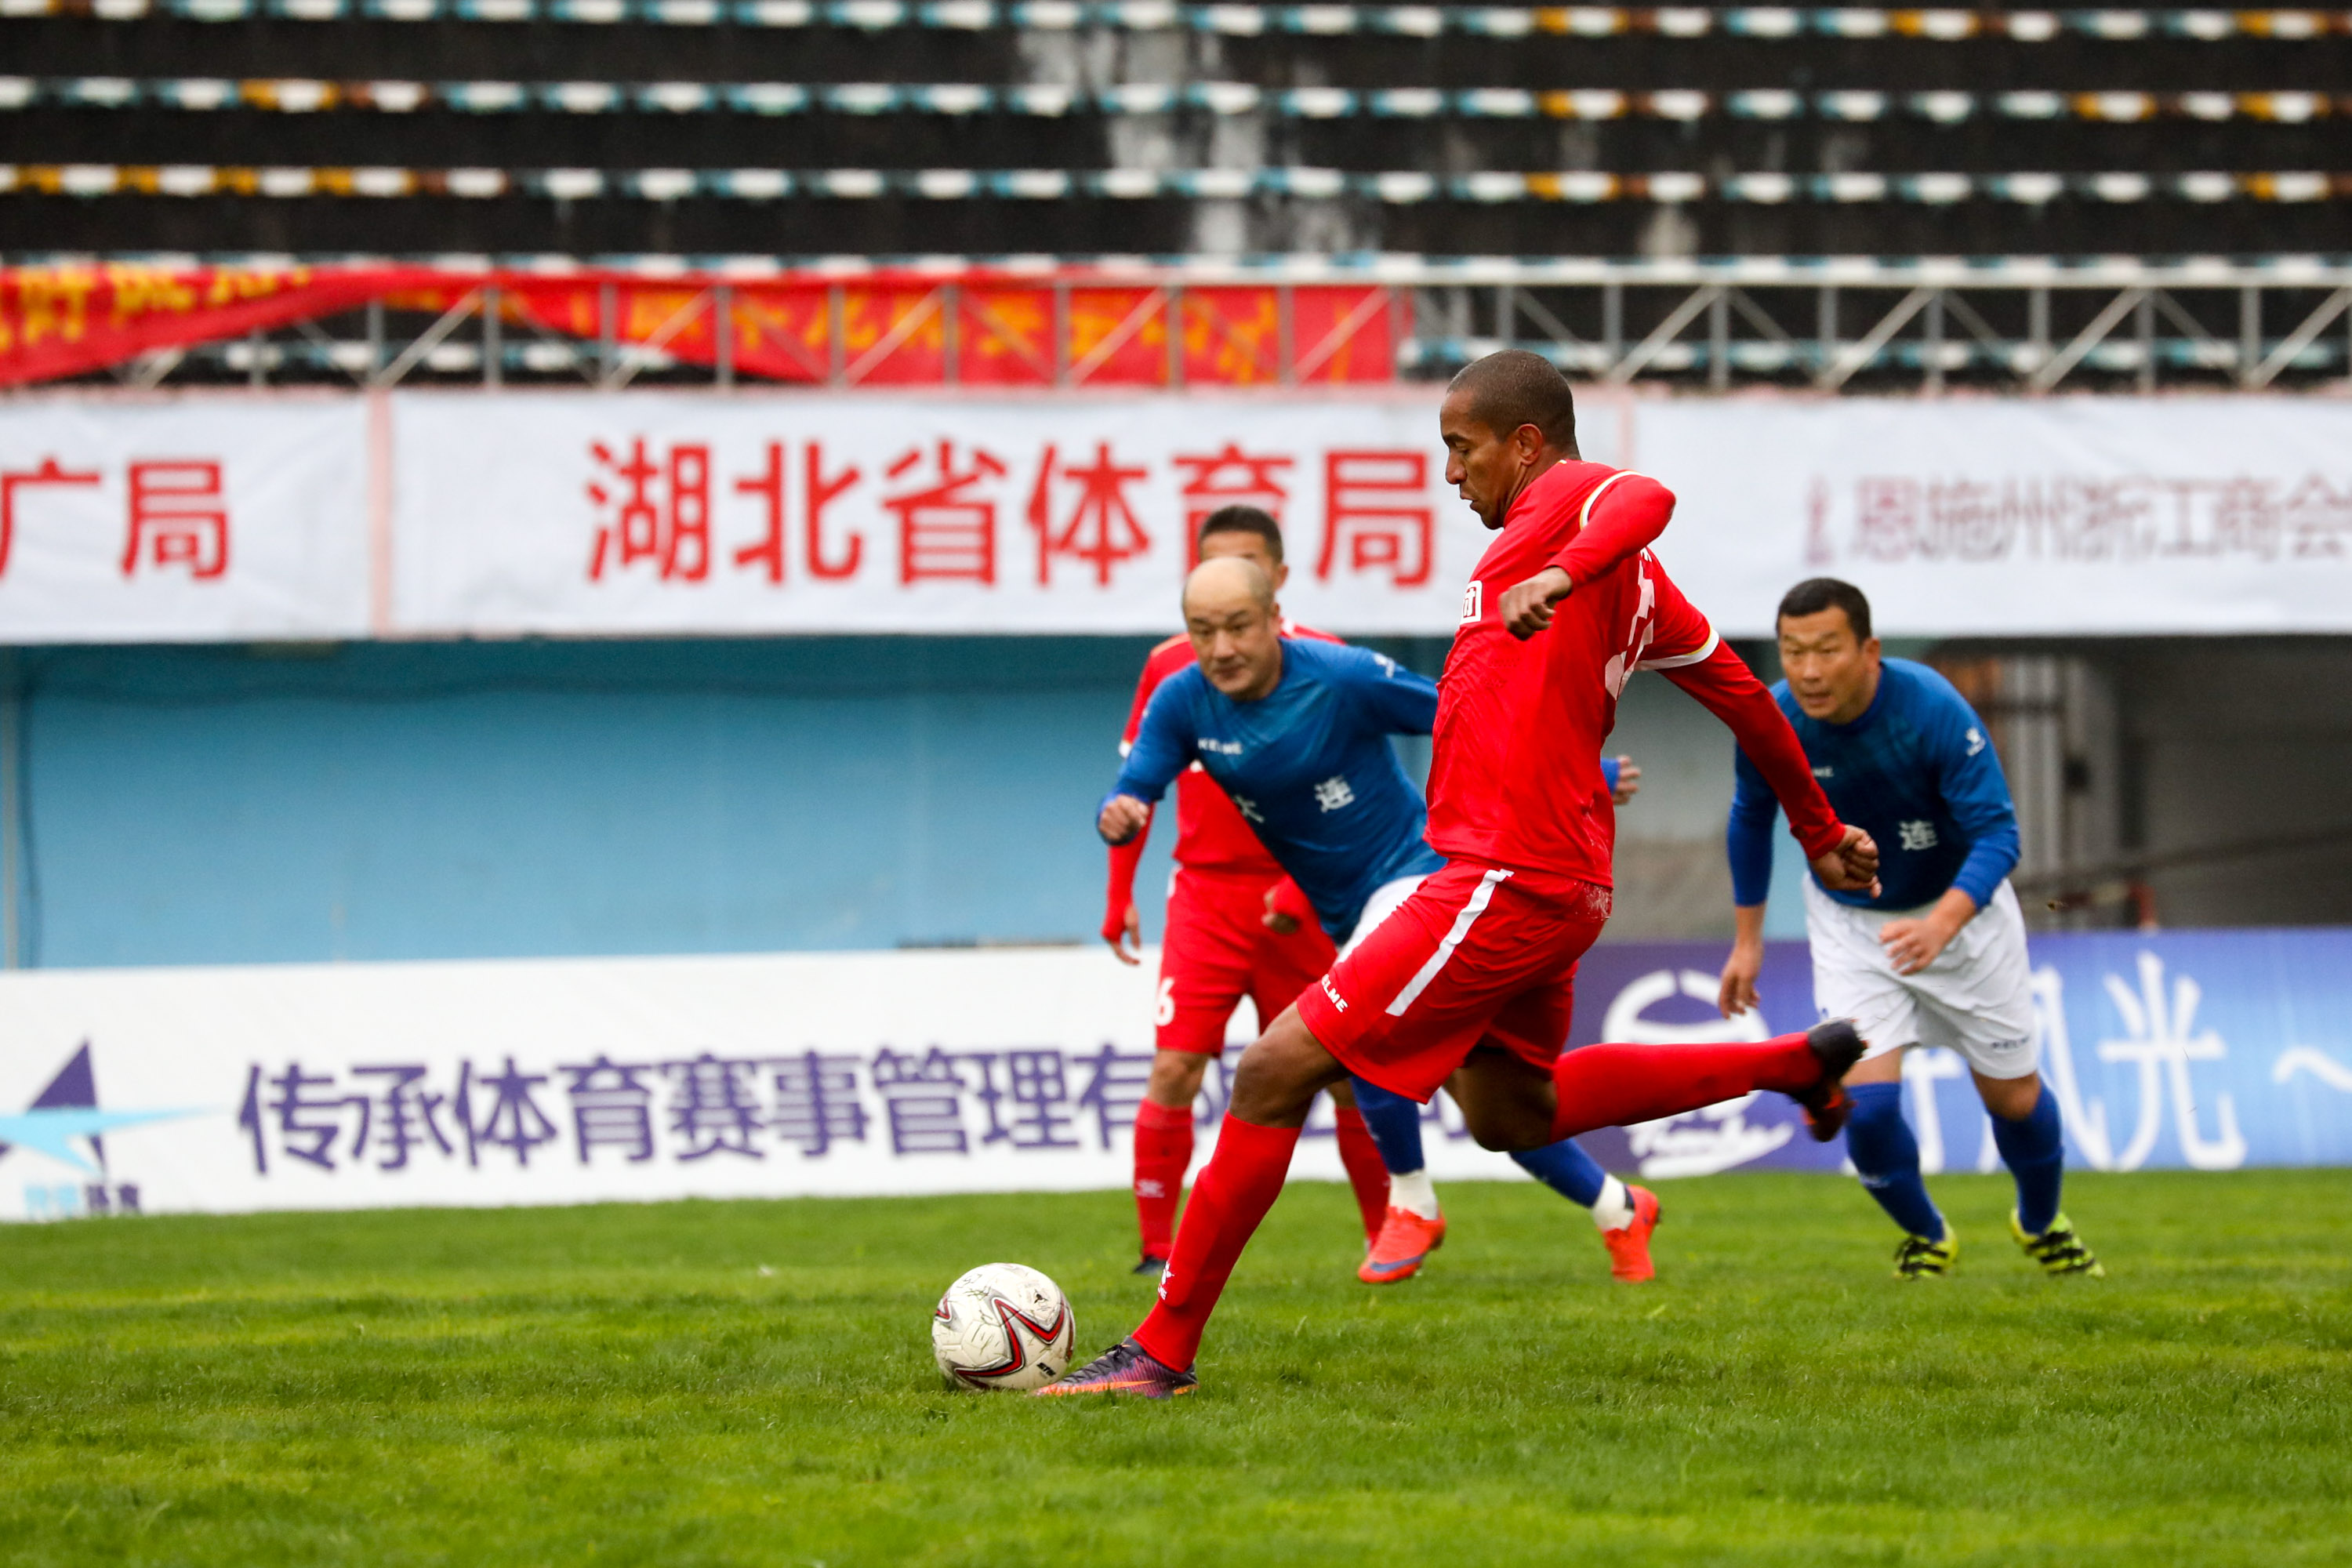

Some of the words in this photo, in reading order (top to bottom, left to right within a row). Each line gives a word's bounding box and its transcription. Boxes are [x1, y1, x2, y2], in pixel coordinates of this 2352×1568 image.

[0, 457, 227, 580] 广局
[586, 434, 1436, 588] 湖北省体育局
[239, 1044, 1474, 1176] 传承体育赛事管理有
